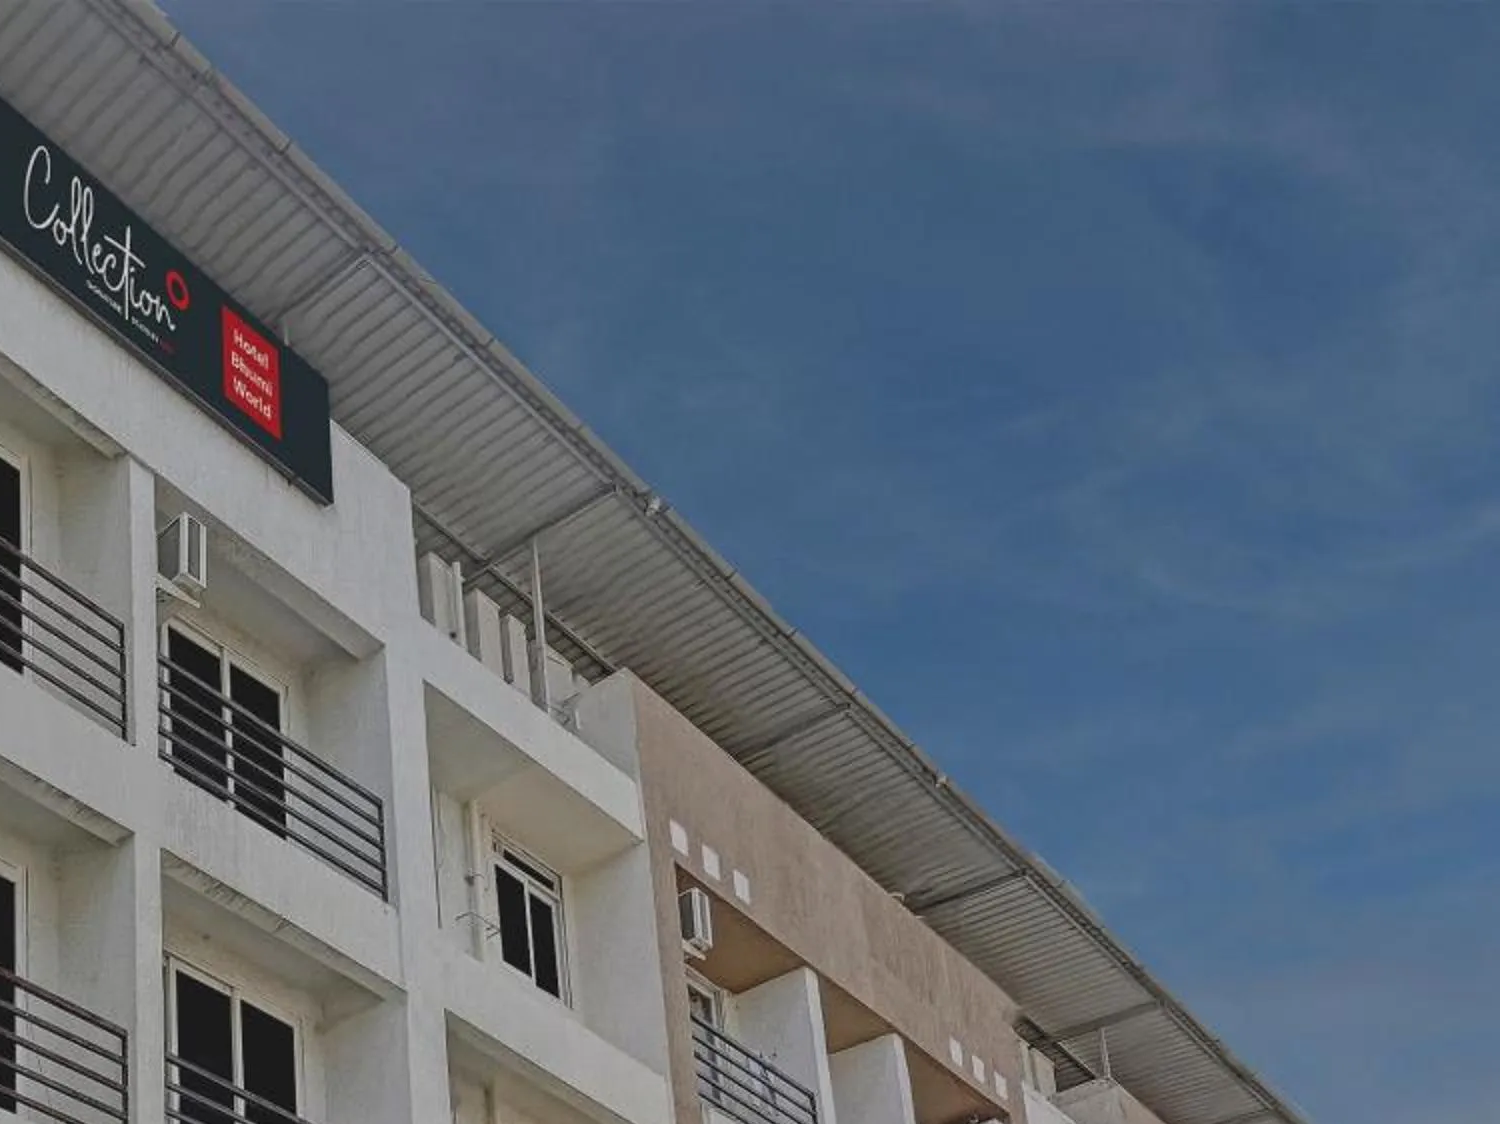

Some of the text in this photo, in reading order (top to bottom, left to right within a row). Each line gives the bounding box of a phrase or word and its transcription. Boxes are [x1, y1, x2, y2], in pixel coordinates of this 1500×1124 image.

[24, 145, 176, 331] Collection
[234, 327, 269, 371] Hotel
[234, 376, 271, 421] World
